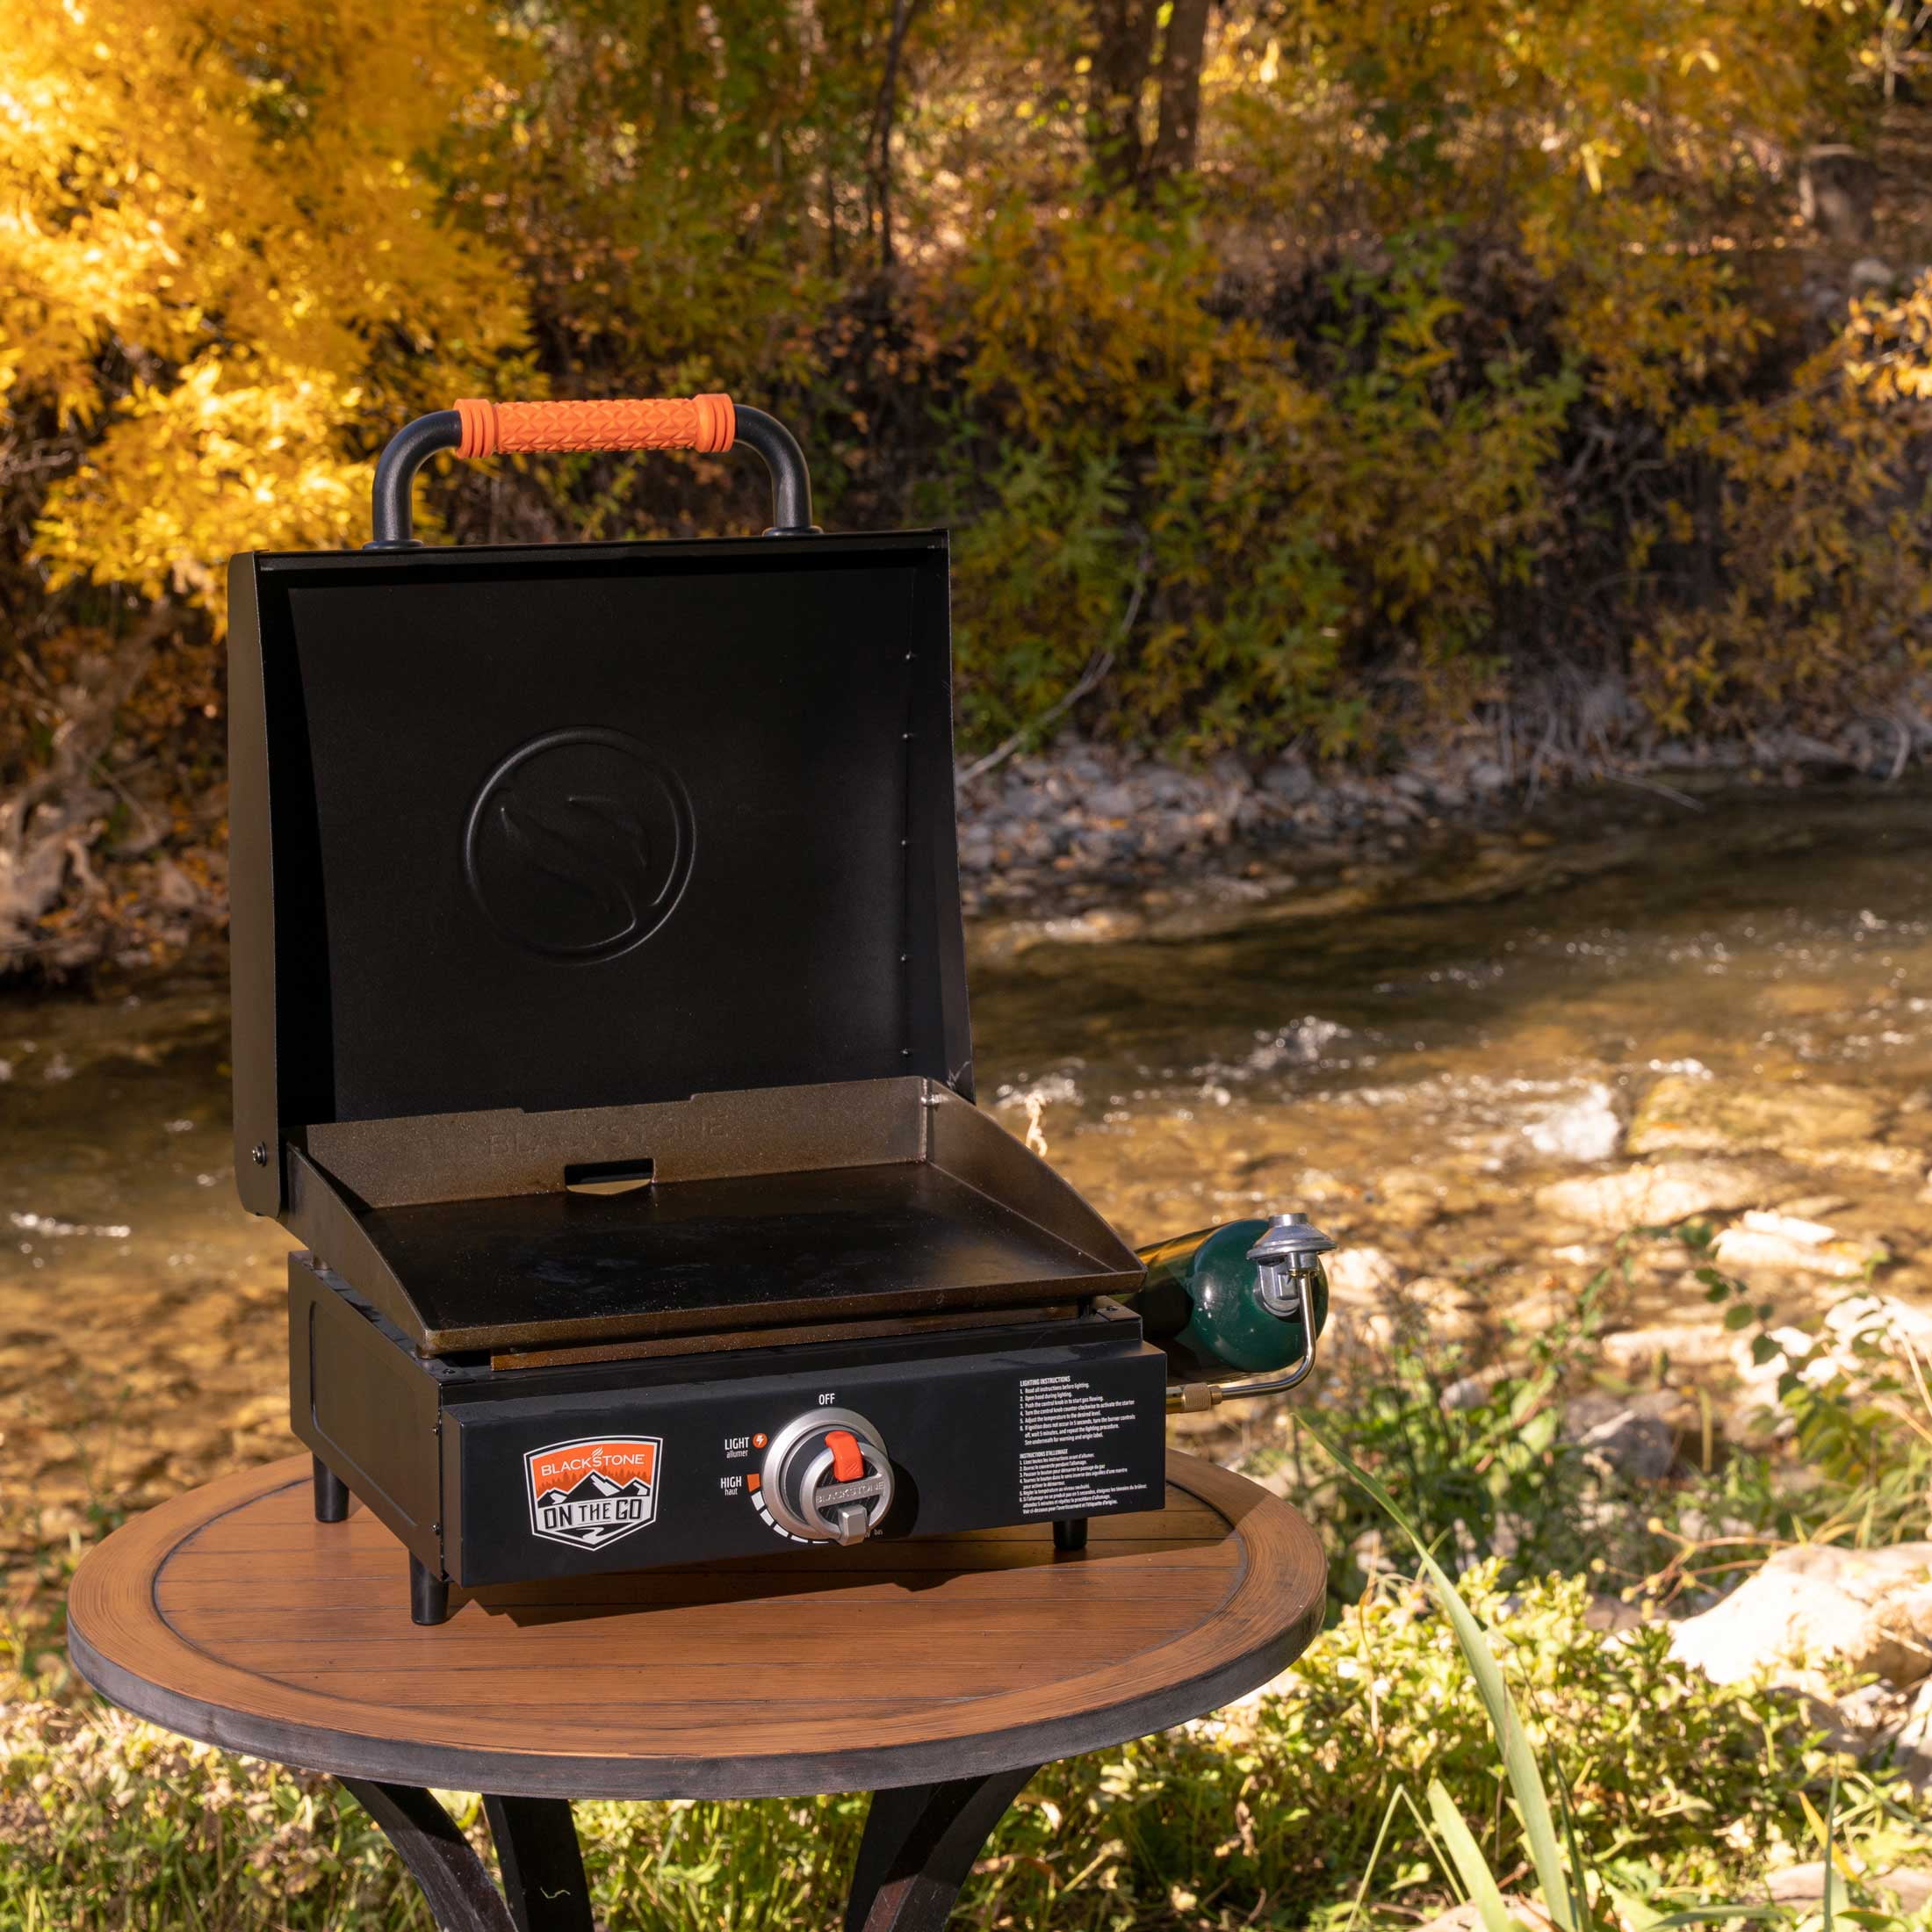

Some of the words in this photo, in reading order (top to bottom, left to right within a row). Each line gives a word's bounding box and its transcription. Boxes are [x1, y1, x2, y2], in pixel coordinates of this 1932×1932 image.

[818, 1393, 836, 1405] OFF
[724, 1437, 750, 1451] LIGHT
[726, 1449, 749, 1459] allumer
[541, 1453, 645, 1476] BLACKSTONE
[720, 1475, 742, 1489] HIGH
[724, 1487, 738, 1496] haut
[544, 1504, 573, 1530] ON
[578, 1503, 611, 1522] THE
[616, 1498, 643, 1521] GO
